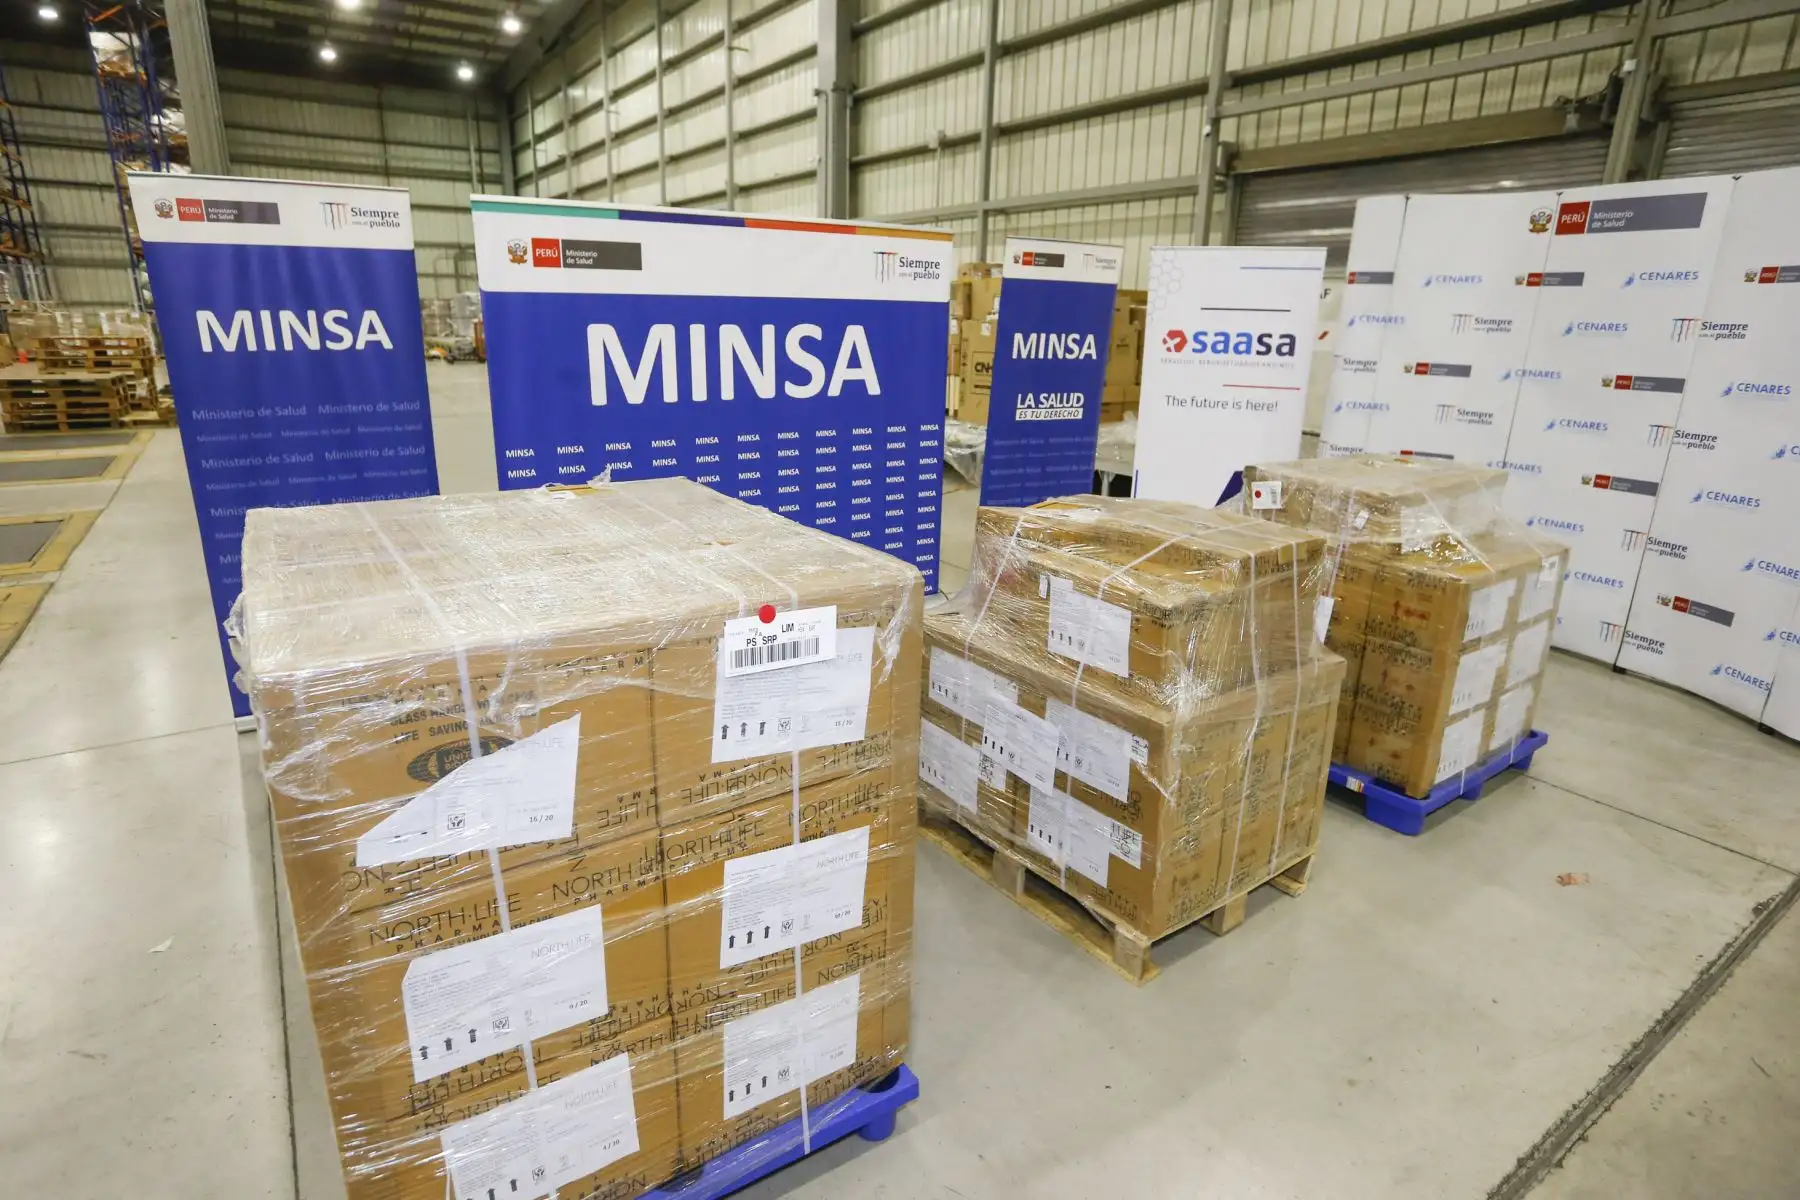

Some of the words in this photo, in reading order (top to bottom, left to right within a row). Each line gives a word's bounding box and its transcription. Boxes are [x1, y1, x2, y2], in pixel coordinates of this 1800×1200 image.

[350, 207, 400, 220] Siempre
[1561, 212, 1585, 223] PERÚ
[1593, 210, 1634, 220] Ministerio
[369, 219, 400, 228] pueblo
[1603, 219, 1625, 228] Salud
[566, 250, 598, 258] Ministerio
[899, 256, 940, 271] Siempre
[914, 271, 940, 280] pueblo
[1435, 275, 1483, 284] CENARES
[1639, 271, 1699, 280] CENARES
[1474, 317, 1513, 327] Siempre
[1576, 322, 1628, 332] CENARES
[1701, 322, 1748, 334] Siempre
[196, 309, 394, 352] MINSA
[1714, 332, 1746, 340] pueblo
[1012, 332, 1097, 360] MINSA
[1192, 330, 1296, 356] saasa
[586, 323, 882, 406] MINSA
[1343, 358, 1378, 367] Siempre
[1514, 368, 1562, 380] CENARES
[1736, 382, 1792, 395] CENARES
[1017, 393, 1035, 408] LA
[1038, 392, 1084, 408] SALUD
[1166, 395, 1187, 407] The
[1190, 396, 1228, 410] future
[1232, 398, 1242, 410] is
[1246, 399, 1278, 412] here!
[192, 408, 254, 420] Ministerio
[258, 408, 272, 418] de
[275, 406, 306, 416] Salud
[318, 402, 374, 414] Ministerio
[376, 402, 390, 412] de
[392, 400, 420, 412] Salud
[1457, 408, 1494, 419] Siempre
[1044, 410, 1080, 418] DERECHO
[1559, 418, 1608, 432] CENARES
[1674, 430, 1718, 443] Siempre
[506, 448, 534, 458] MINSA
[556, 445, 584, 455] MINSA
[606, 442, 632, 452] MINSA
[652, 439, 676, 448] MINSA
[696, 436, 720, 445] MINSA
[738, 433, 760, 442] MINSA
[778, 431, 800, 440] MINSA
[1687, 442, 1716, 450] pueblo
[325, 450, 380, 461] Ministerio
[382, 448, 395, 458] de
[397, 446, 426, 456] Salud
[508, 468, 536, 479] MINSA
[558, 464, 586, 475] MINSA
[652, 457, 678, 467] MINSA
[696, 454, 720, 464] MINSA
[738, 451, 760, 460] MINSA
[778, 448, 800, 457] MINSA
[816, 446, 836, 455] MINSA
[852, 443, 872, 452] MINSA
[886, 441, 906, 450] MINSA
[201, 457, 262, 468] Ministerio
[265, 456, 279, 464] de
[282, 453, 314, 464] Salud
[738, 471, 760, 480] MINSA
[778, 468, 800, 477] MINSA
[886, 459, 906, 468] MINSA
[739, 489, 762, 497] MINSA
[778, 485, 800, 494] MINSA
[816, 481, 836, 490] MINSA
[852, 478, 872, 487] MINSA
[886, 475, 904, 484] MINSA
[918, 472, 936, 481] MINSA
[816, 500, 836, 509] MINSA
[852, 496, 872, 505] MINSA
[1706, 491, 1760, 508] CENARES
[816, 516, 836, 525] MINSA
[852, 512, 870, 521] MINSA
[886, 508, 904, 517] MINSA
[1538, 517, 1584, 532] CENARES
[852, 530, 871, 538] MINSA
[916, 537, 934, 546] MINSA
[1648, 537, 1688, 552] Siempre
[1660, 550, 1686, 560] pueblo
[1758, 560, 1800, 580] CENARE
[1574, 572, 1624, 588] CENARES
[782, 623, 794, 633] LIM
[746, 638, 757, 647] PS
[762, 634, 778, 646] SRP
[1625, 630, 1665, 648] Siempre
[1636, 644, 1664, 656] pueblo
[1724, 666, 1770, 692] CENARES
